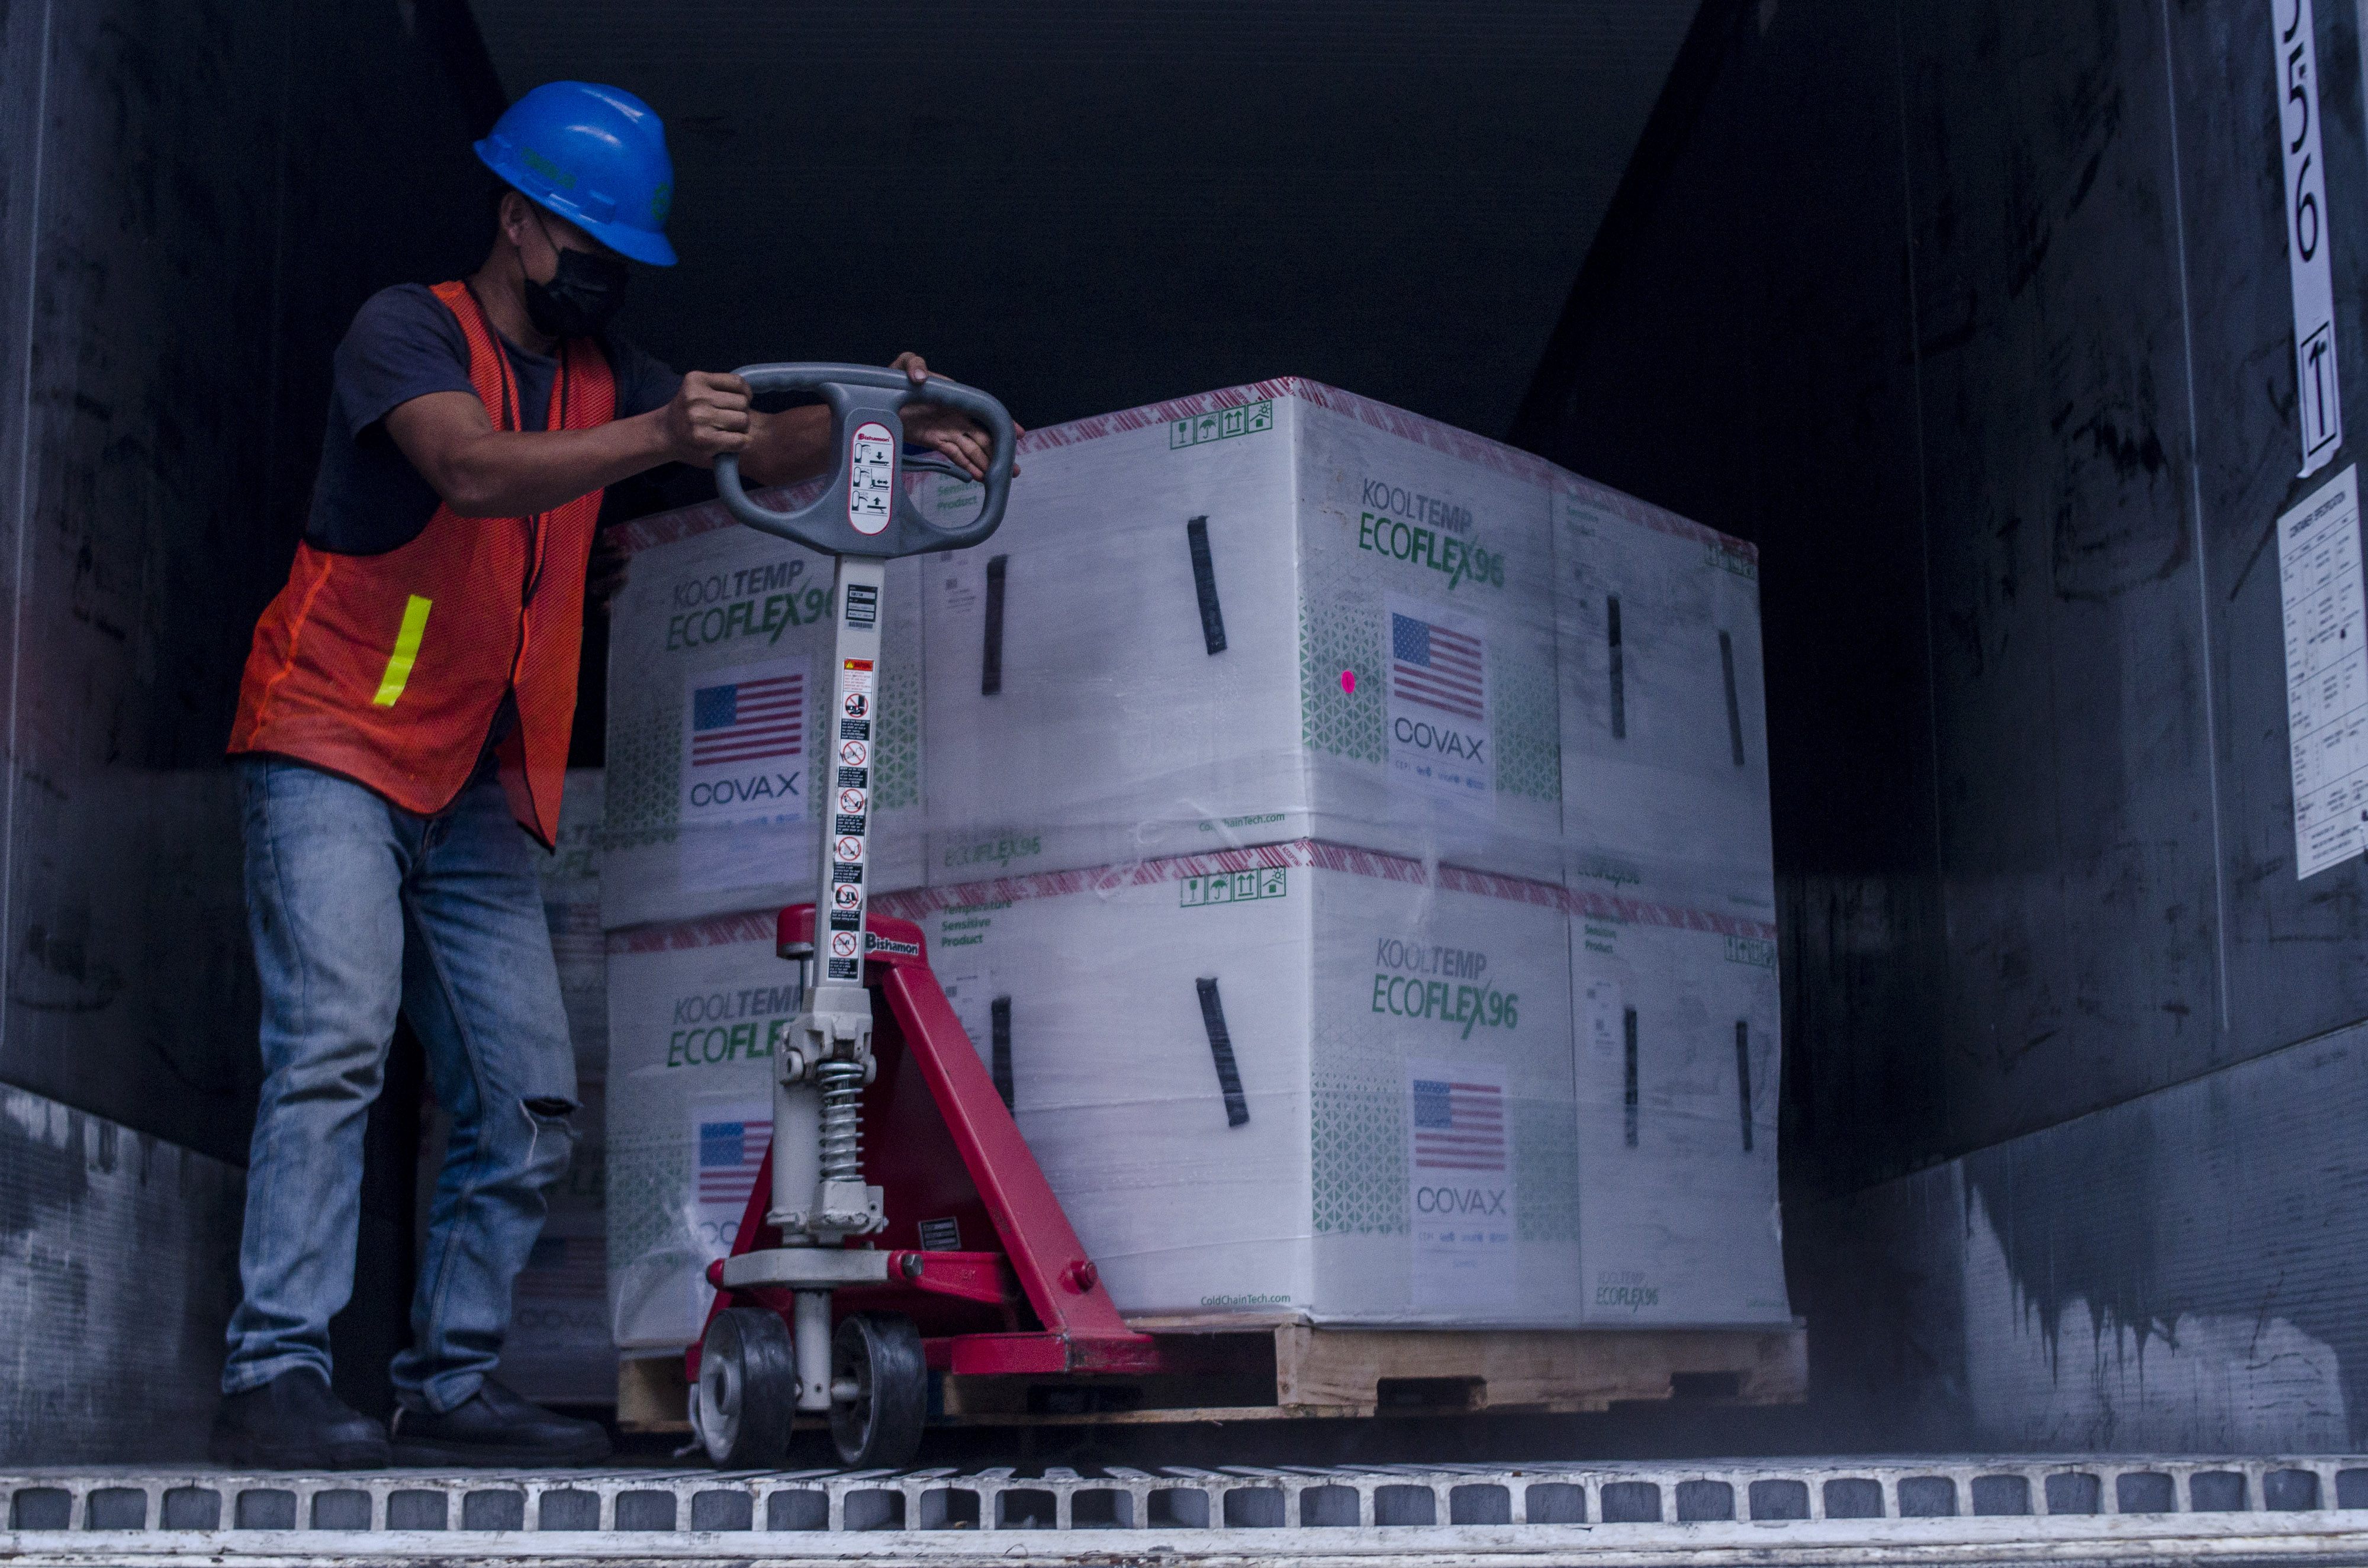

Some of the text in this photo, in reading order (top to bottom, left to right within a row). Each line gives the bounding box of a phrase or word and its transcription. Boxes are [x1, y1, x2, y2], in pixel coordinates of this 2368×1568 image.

[858, 433, 890, 443] Bishamon
[1362, 478, 1473, 534] KOOLTEMP
[1359, 511, 1505, 591] ECOFLEX96
[673, 559, 805, 608] KOOLTEMP
[1394, 717, 1484, 762] COVAX
[690, 772, 800, 807] COVAX
[941, 917, 992, 932] Sensitive
[941, 932, 983, 948] Product
[865, 933, 918, 954] Bishamon
[1376, 937, 1487, 980] KOOLTEMP
[1372, 973, 1519, 1041] ECOFLEX96
[1417, 1186, 1507, 1217] COVAX
[1201, 1293, 1291, 1306] ColdChainTech.com
